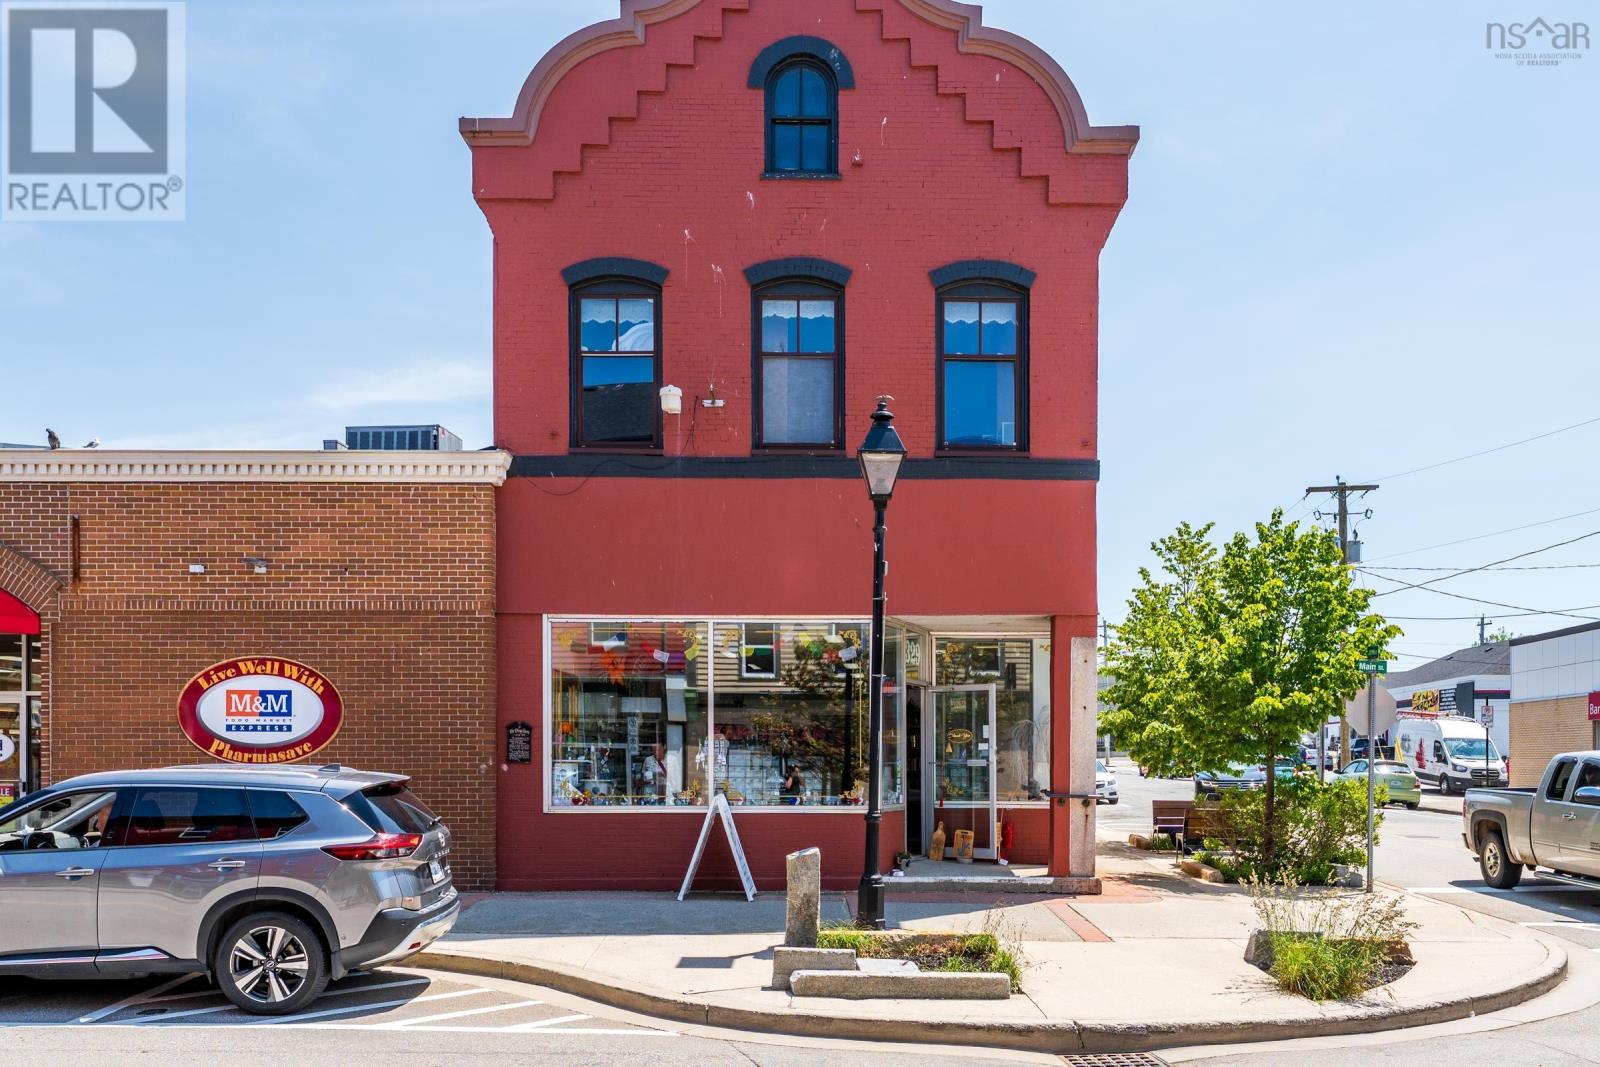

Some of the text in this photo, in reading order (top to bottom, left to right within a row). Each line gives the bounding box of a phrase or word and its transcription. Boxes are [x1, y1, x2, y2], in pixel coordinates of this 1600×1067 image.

[197, 660, 325, 694] Live Well With
[1358, 662, 1377, 671] Main
[230, 694, 288, 713] M&M
[209, 738, 313, 763] Pharmasave
